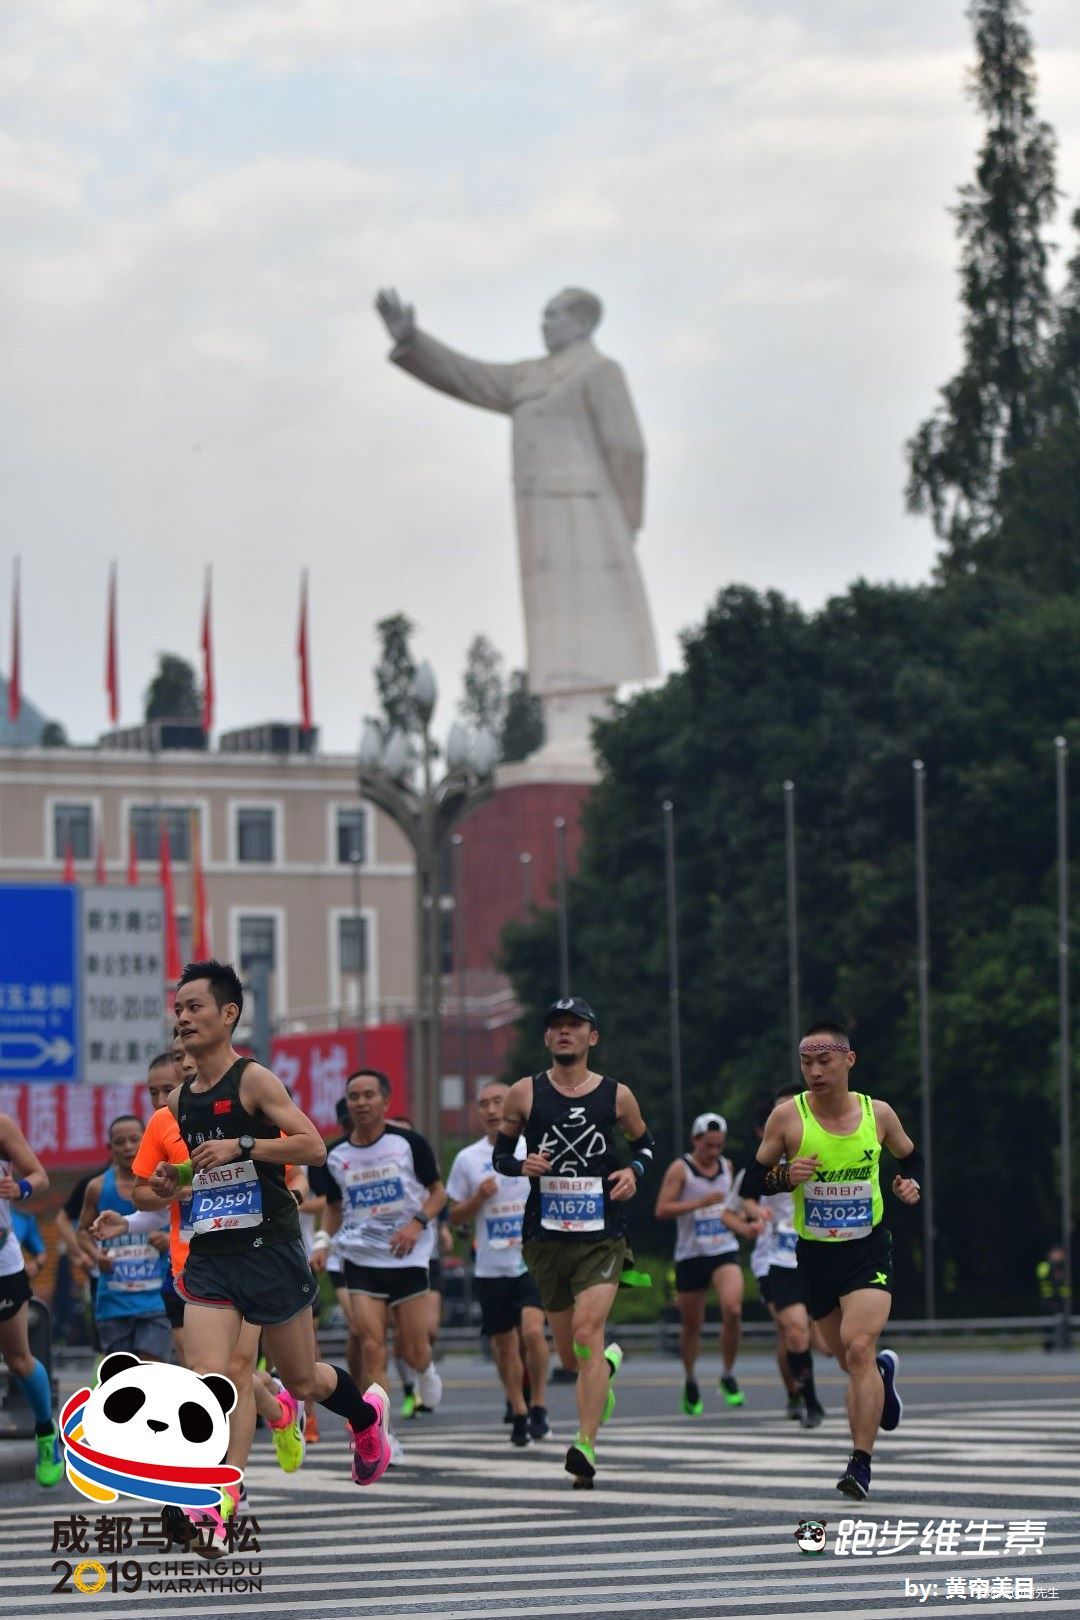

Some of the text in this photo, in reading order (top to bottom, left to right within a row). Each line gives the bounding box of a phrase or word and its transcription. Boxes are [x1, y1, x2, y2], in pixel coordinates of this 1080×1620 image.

[198, 1166, 246, 1185] 东风日产
[814, 1186, 863, 1196] 东风日产
[199, 1191, 253, 1213] D2591
[548, 1200, 596, 1214] A1678
[810, 1206, 867, 1220] A3022
